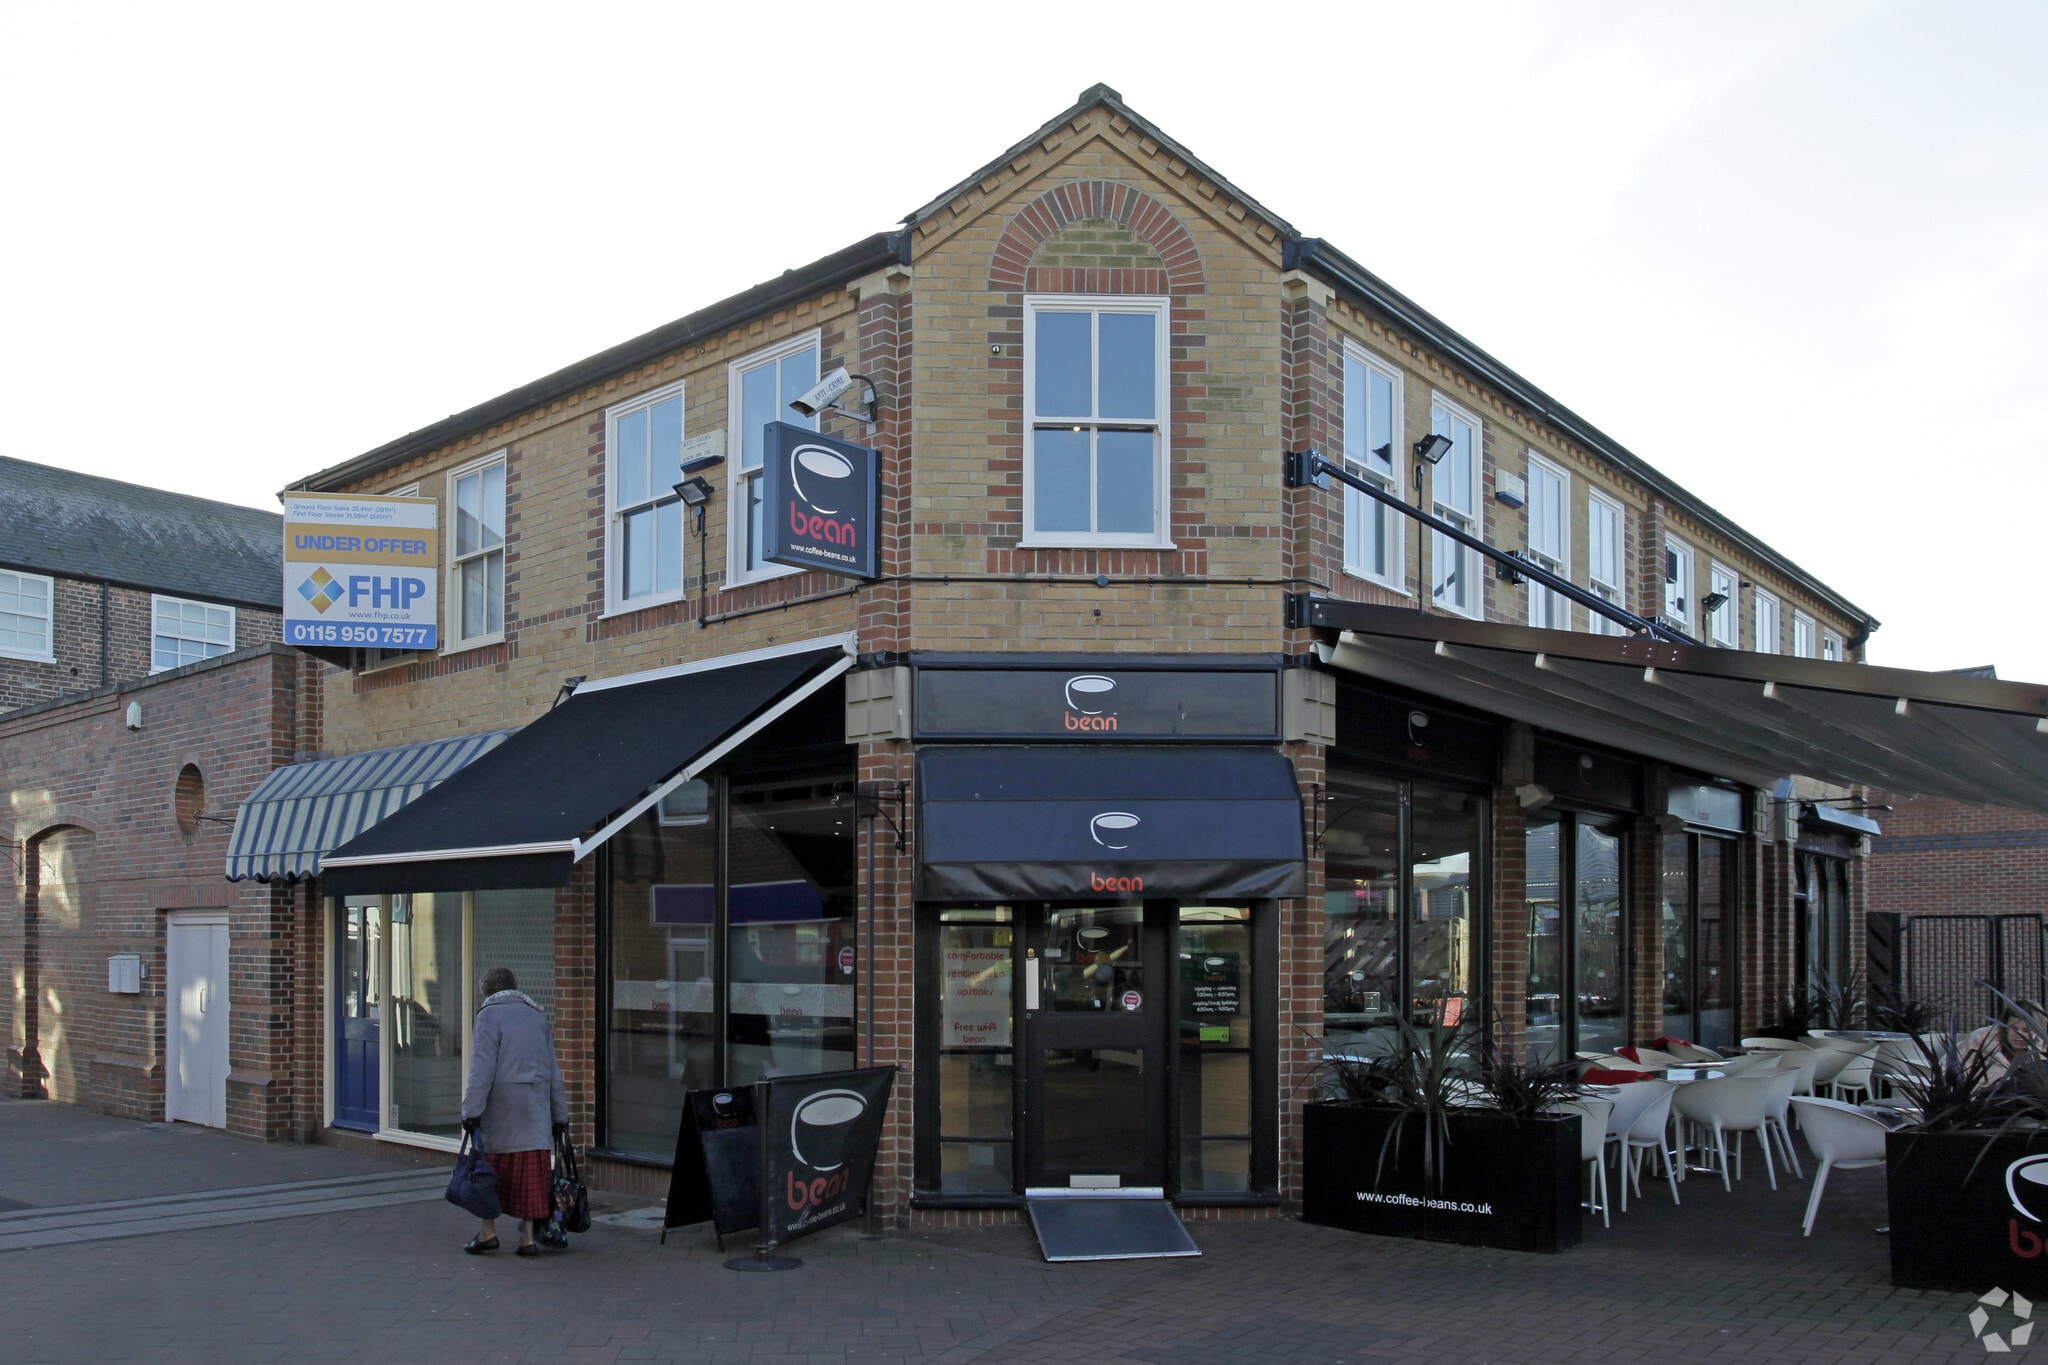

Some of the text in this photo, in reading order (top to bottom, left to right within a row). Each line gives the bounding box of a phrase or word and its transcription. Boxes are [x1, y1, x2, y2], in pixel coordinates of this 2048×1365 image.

[828, 376, 844, 392] CRIME
[790, 500, 856, 548] bean
[295, 534, 427, 555] UNDER OFFER
[790, 542, 857, 564] www.coffee-beans.co.uk
[348, 575, 426, 610] FHP
[348, 610, 411, 620] www.fhp.co.uk
[294, 624, 428, 644] 0115 950 7577
[1064, 710, 1118, 732] bean
[1090, 872, 1144, 892] bean
[948, 951, 1004, 962] comfortable
[956, 988, 994, 997] upstairs
[954, 1022, 974, 1032] free
[962, 1034, 986, 1043] bean
[787, 1168, 850, 1211] bean
[1356, 1191, 1492, 1214] www.coffee-beans.co.uk
[2009, 1218, 2048, 1259] b
